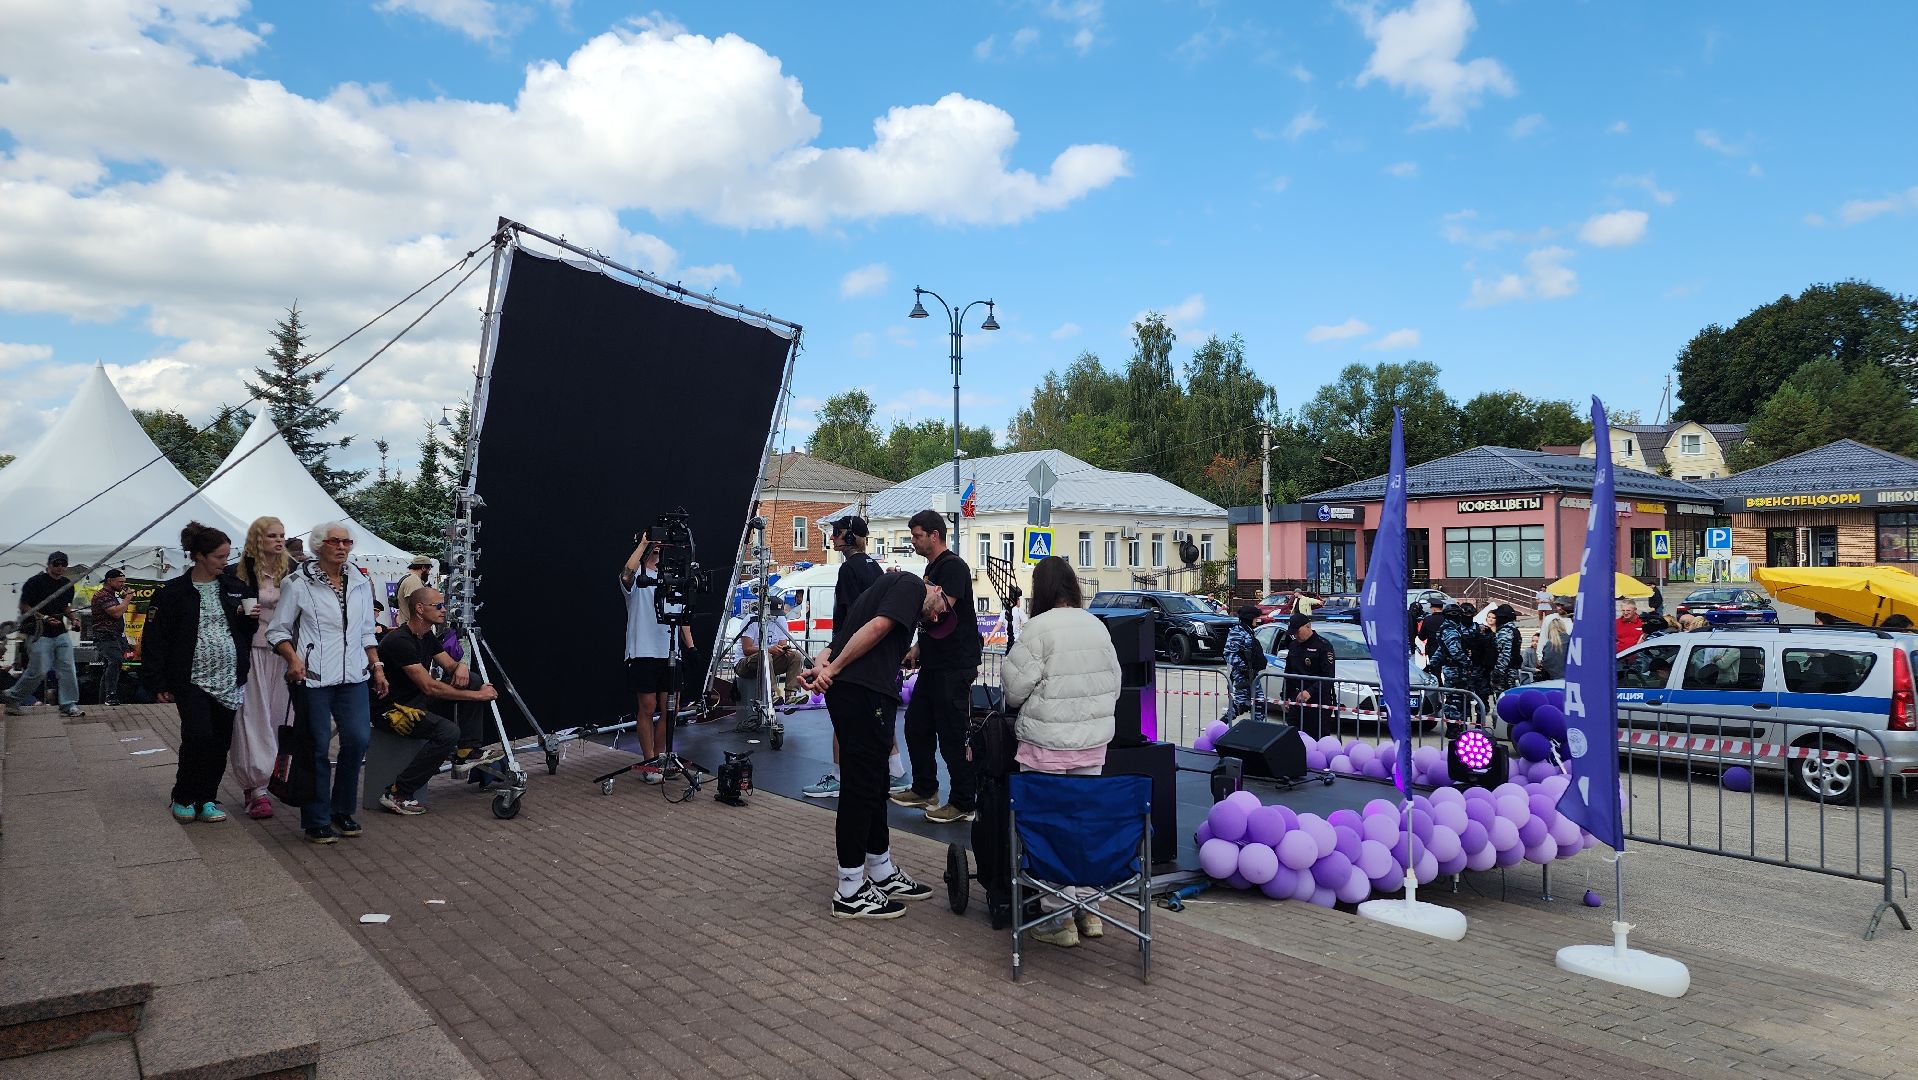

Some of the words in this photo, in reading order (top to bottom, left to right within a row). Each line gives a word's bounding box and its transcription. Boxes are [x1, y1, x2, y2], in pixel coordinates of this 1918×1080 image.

[1458, 497, 1541, 513] КОФЕ&ЦВЕТЫ
[1712, 529, 1727, 548] P
[1616, 692, 1645, 702] ИЦИЯ
